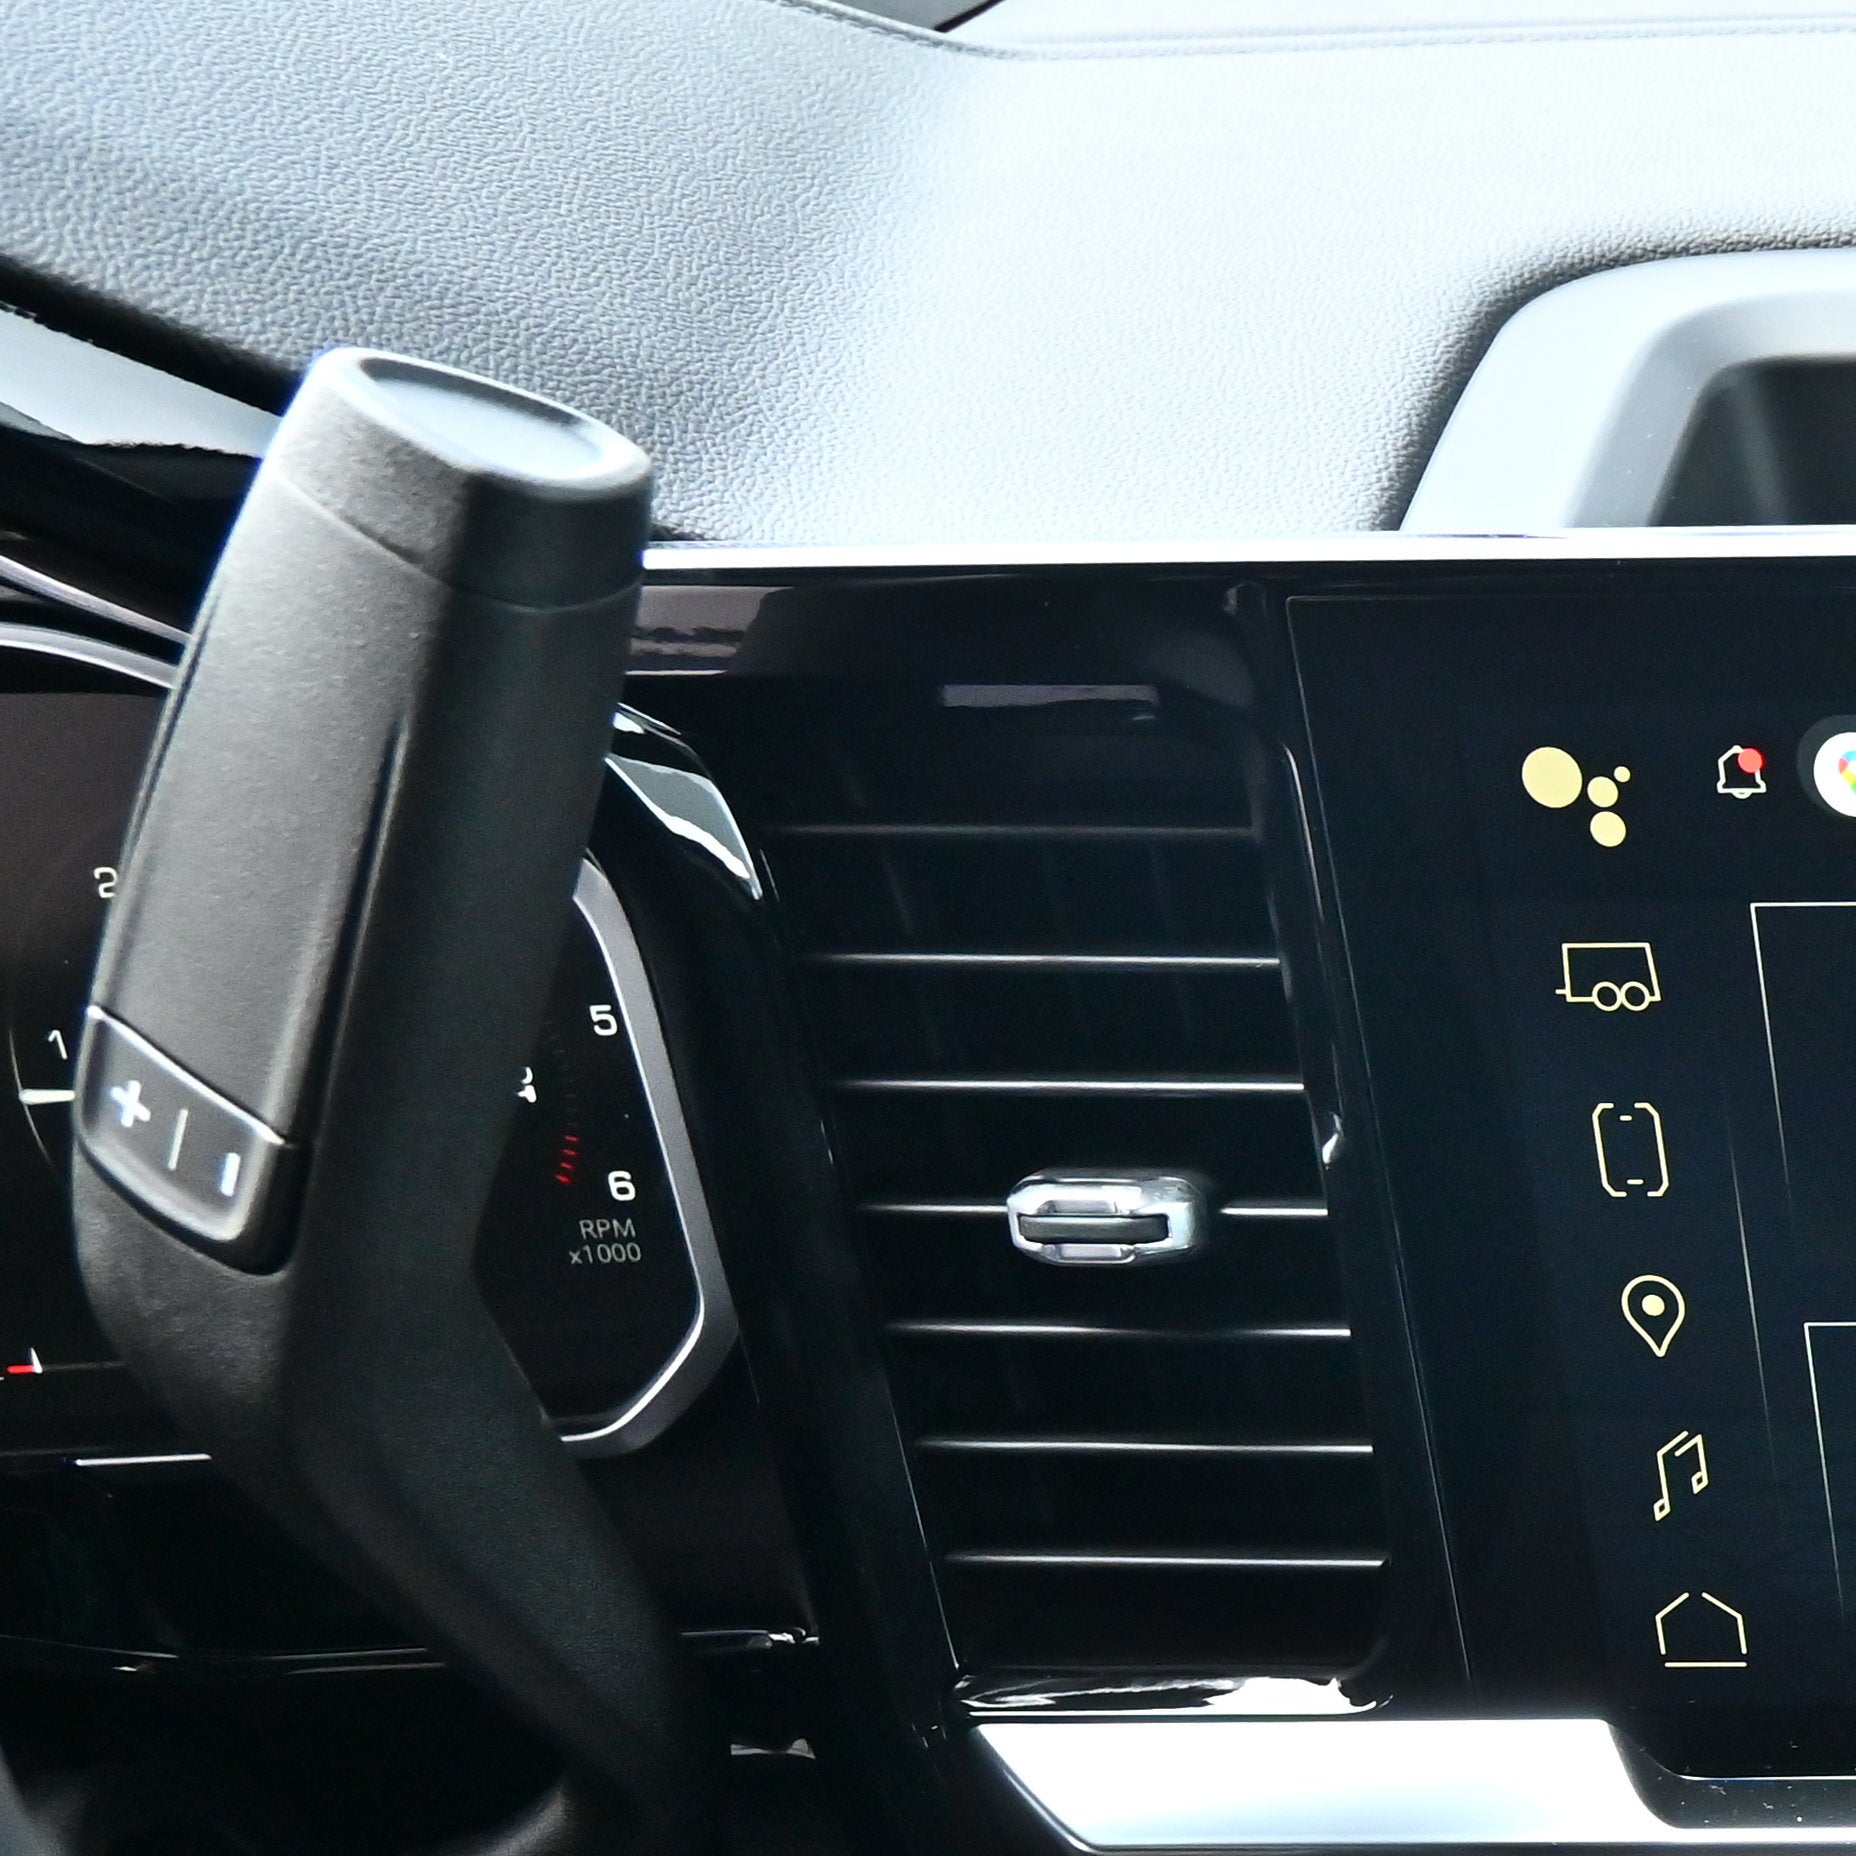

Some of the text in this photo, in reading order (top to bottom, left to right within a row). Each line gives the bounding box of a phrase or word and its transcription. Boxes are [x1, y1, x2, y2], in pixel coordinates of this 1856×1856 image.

[93, 866, 118, 898] 2
[589, 1003, 619, 1037] 5
[47, 1029, 68, 1060] 1
[607, 1170, 636, 1202] 6
[579, 1218, 636, 1240] RPM
[569, 1242, 642, 1265] x1000
